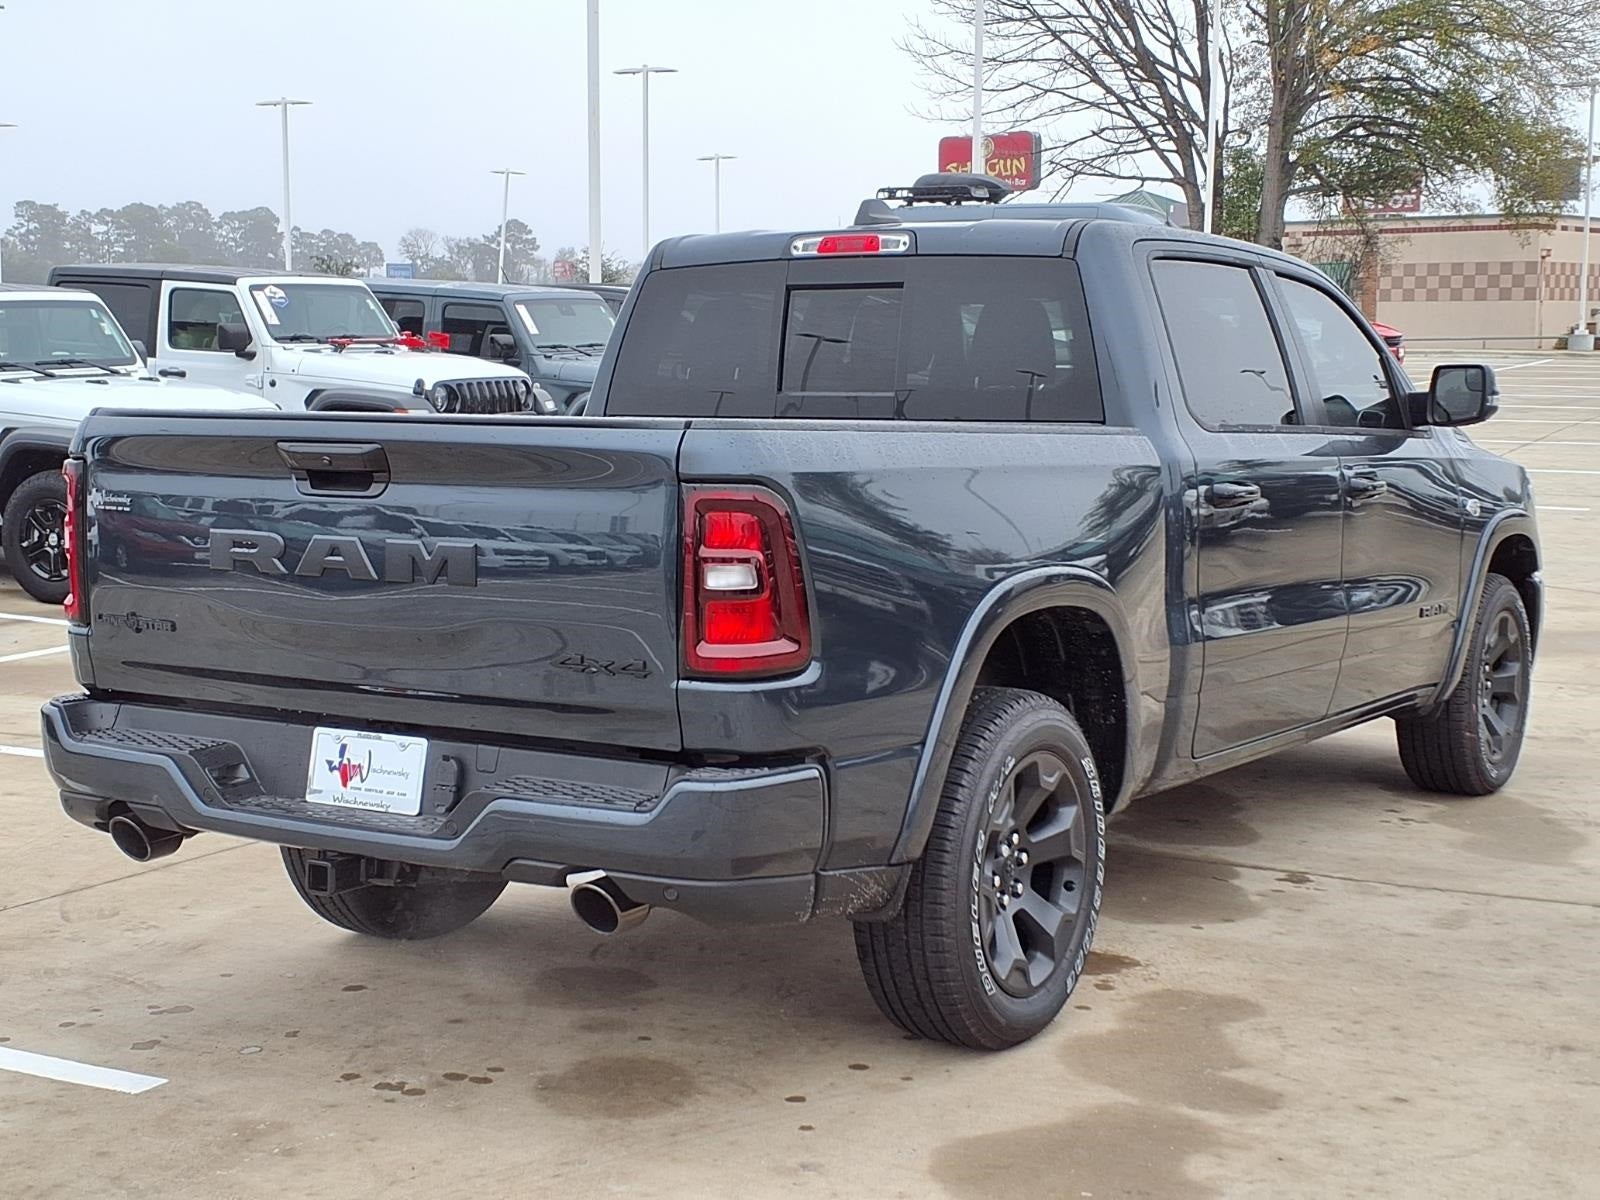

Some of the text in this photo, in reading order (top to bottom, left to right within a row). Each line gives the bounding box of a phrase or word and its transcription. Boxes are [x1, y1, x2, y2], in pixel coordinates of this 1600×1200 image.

[946, 157, 1026, 177] SHGUN
[210, 528, 478, 587] RAM
[971, 829, 997, 996] DUELER
